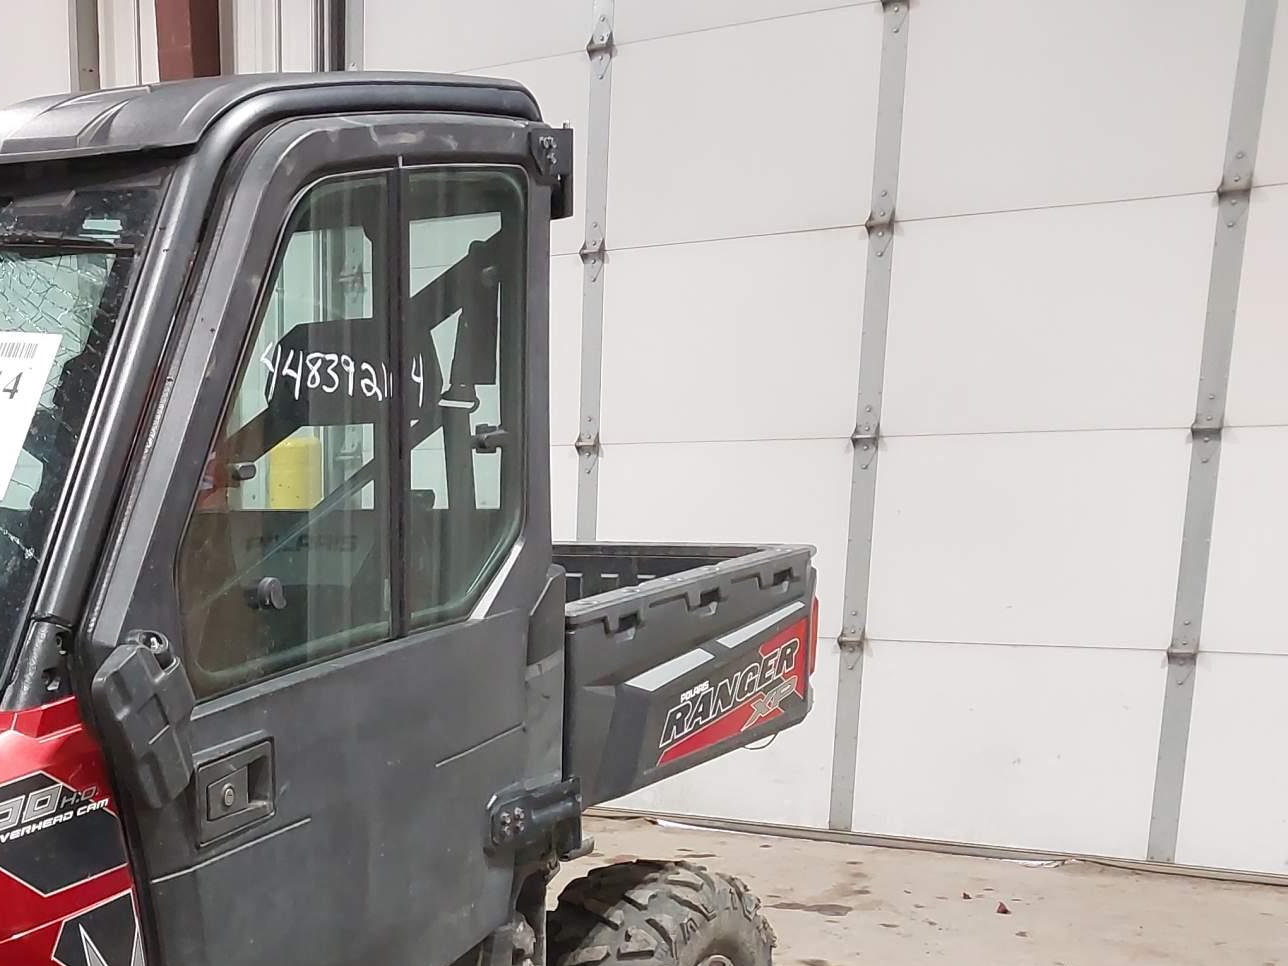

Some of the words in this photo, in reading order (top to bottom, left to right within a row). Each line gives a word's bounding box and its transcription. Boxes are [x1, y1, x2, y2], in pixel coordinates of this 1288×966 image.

[658, 637, 800, 749] RANGER
[680, 680, 710, 702] POLARIS
[740, 674, 798, 732] XP
[76, 797, 110, 816] CAM
